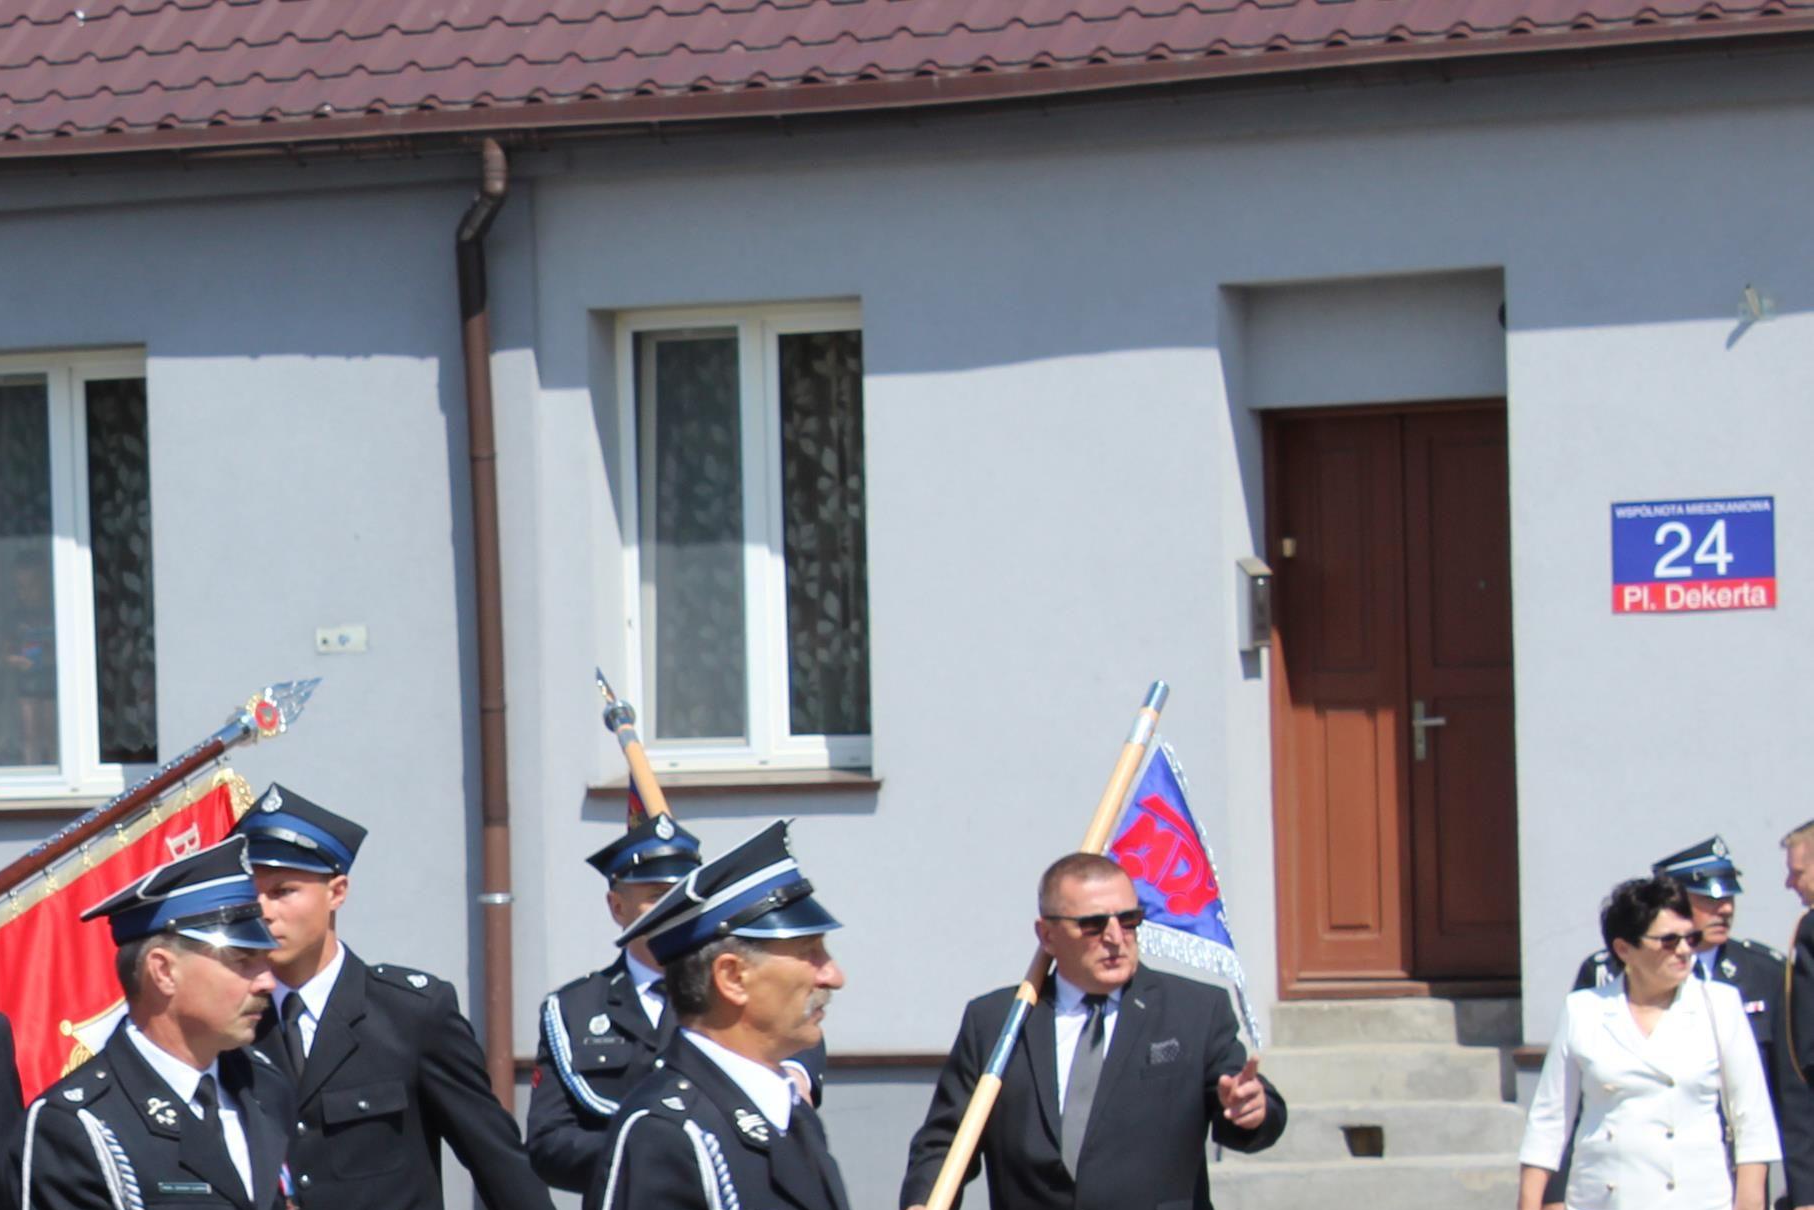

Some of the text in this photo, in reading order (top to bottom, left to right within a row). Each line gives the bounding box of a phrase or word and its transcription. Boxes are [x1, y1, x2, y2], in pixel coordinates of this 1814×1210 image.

[1654, 518, 1734, 578] 24
[1623, 582, 1767, 611] Pl. Dekerta
